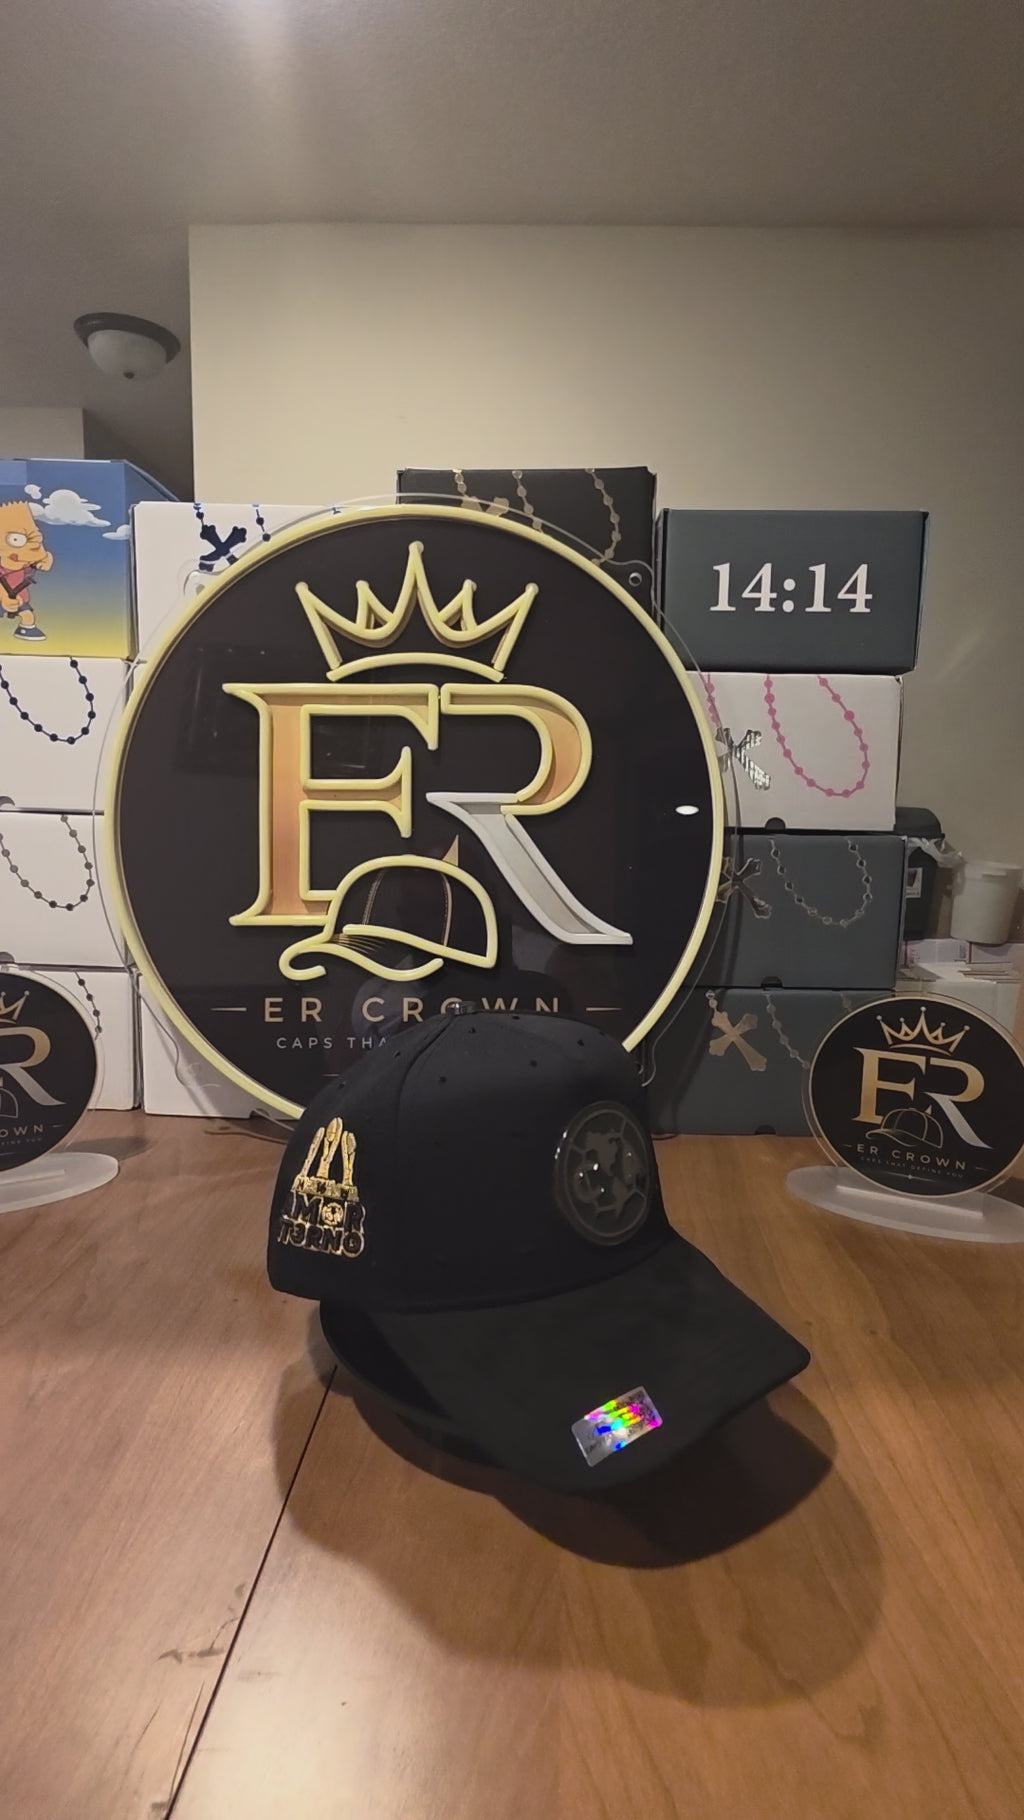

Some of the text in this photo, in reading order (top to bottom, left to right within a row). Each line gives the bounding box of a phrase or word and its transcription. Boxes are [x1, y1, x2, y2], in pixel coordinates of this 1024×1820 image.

[709, 562, 873, 613] 14:14
[222, 683, 633, 945] ER
[264, 997, 323, 1023] ER
[276, 1037, 333, 1049] CAPS
[0, 1026, 67, 1106] R
[851, 1046, 994, 1150] ER
[0, 1123, 44, 1138] OWN
[857, 1143, 966, 1170] ER CROWN
